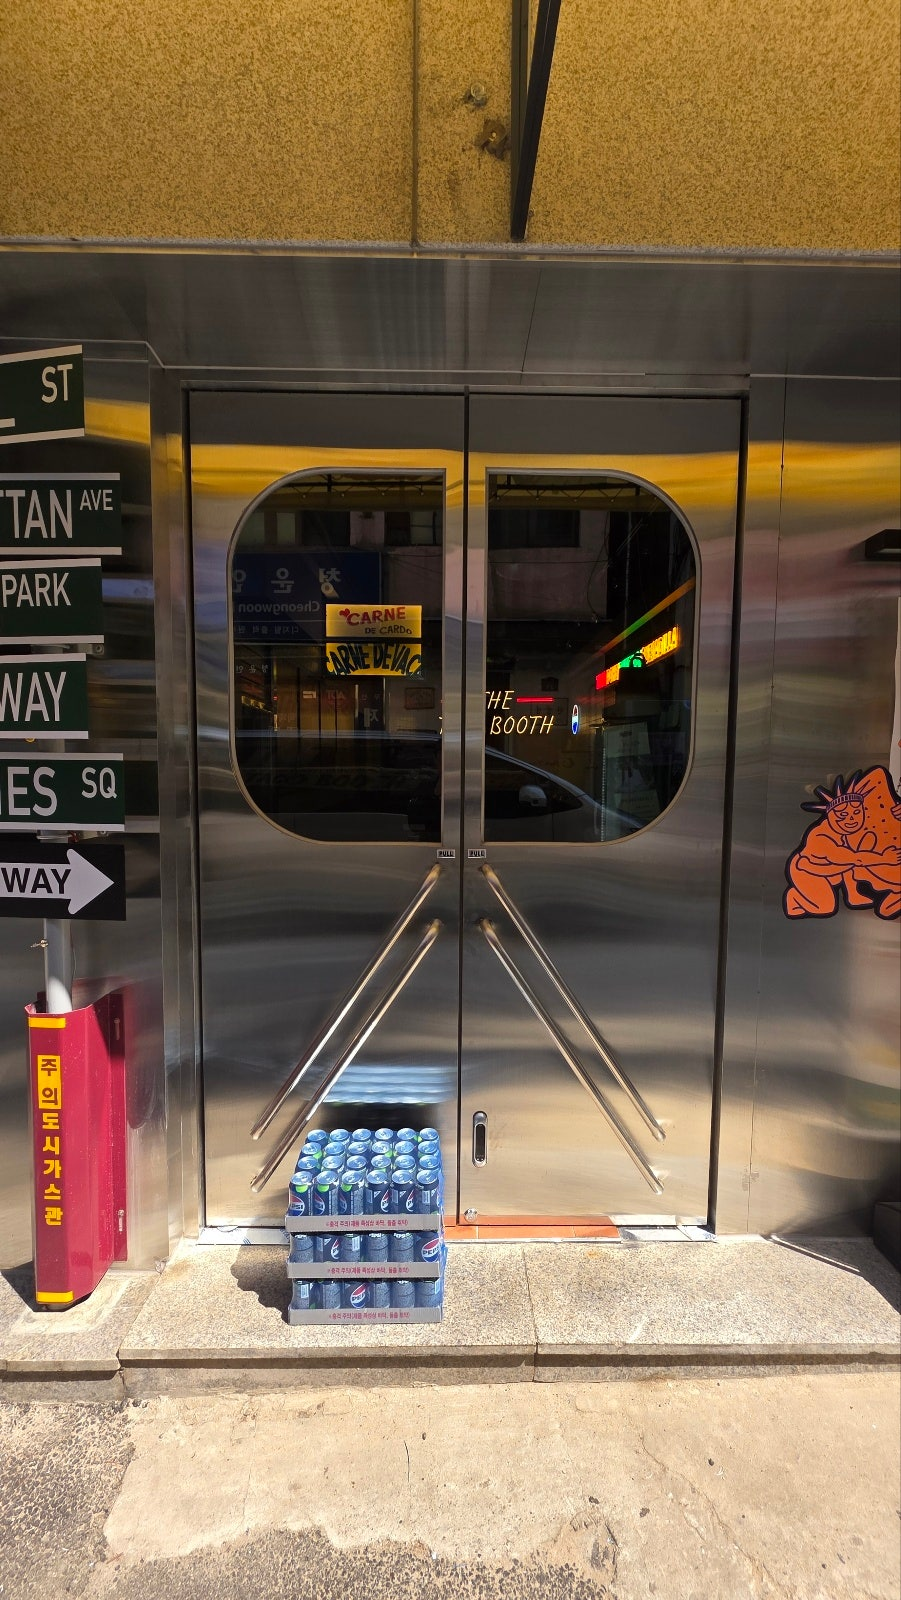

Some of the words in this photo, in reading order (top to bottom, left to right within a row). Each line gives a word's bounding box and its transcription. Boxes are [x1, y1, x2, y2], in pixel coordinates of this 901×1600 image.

[41, 363, 73, 404] ST
[0, 489, 73, 539] TAN
[79, 489, 114, 511] AVE
[1, 572, 72, 608] PARK
[346, 606, 406, 626] CARNE
[365, 627, 376, 635] DE
[0, 671, 67, 722] WAY
[490, 715, 555, 735] BOOTH
[0, 766, 58, 817] ES
[81, 767, 117, 799] SQ
[1, 867, 72, 895] WAY
[40, 1058, 58, 1106] 주의
[42, 1112, 63, 1226] 도시가스관
